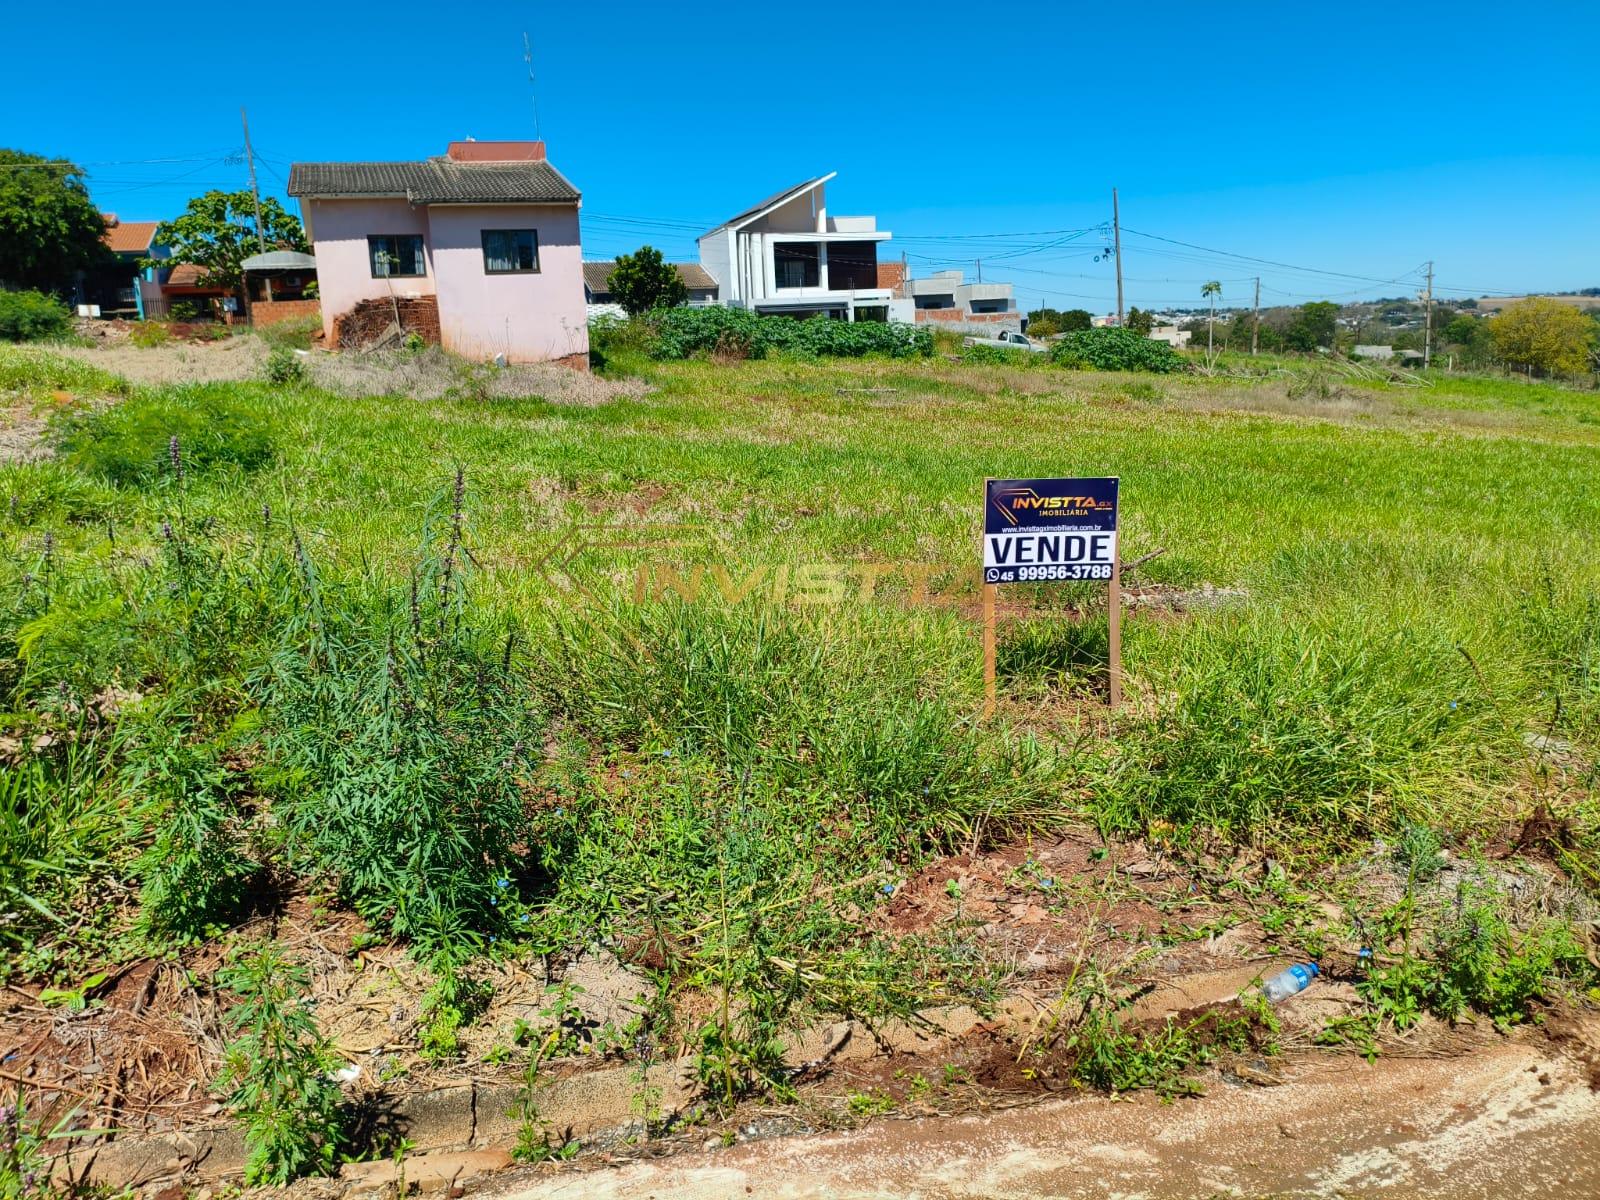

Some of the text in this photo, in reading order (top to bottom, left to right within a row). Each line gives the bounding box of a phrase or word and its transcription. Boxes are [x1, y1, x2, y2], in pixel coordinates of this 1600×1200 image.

[991, 535, 1110, 564] VENDE
[1000, 565, 1112, 581] 45 99956-3788
